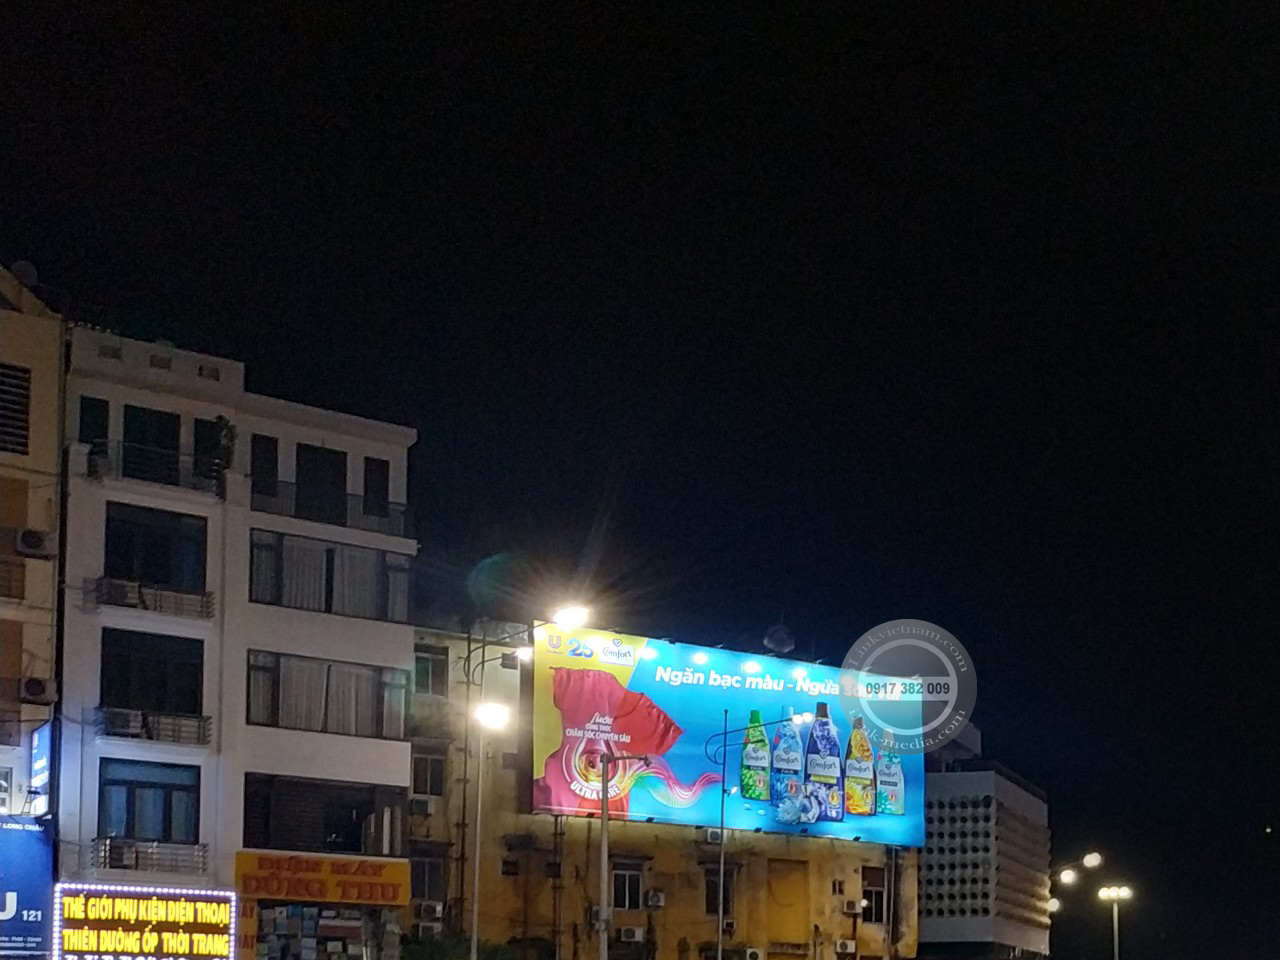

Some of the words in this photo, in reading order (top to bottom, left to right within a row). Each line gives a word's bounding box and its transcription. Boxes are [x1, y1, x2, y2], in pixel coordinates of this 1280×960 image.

[602, 646, 632, 659] Comfort
[655, 666, 705, 686] Ngăn
[709, 669, 741, 691] bạc
[745, 674, 784, 691] màu
[796, 675, 839, 696] Ngừa
[809, 758, 837, 772] Comfort
[570, 780, 598, 800] ULTRA
[599, 784, 620, 799] CRE
[2, 822, 23, 830] LONG
[22, 910, 41, 921] 121
[62, 891, 87, 919] THẾ
[87, 894, 113, 919] GIỚI
[114, 898, 138, 924] PHỤ
[138, 896, 166, 925] KIỆN
[195, 901, 230, 928] THOẠI
[62, 925, 98, 951] THIÊN
[142, 924, 158, 953] ỐP
[161, 929, 189, 954] THỜI
[192, 933, 229, 955] TRANG
